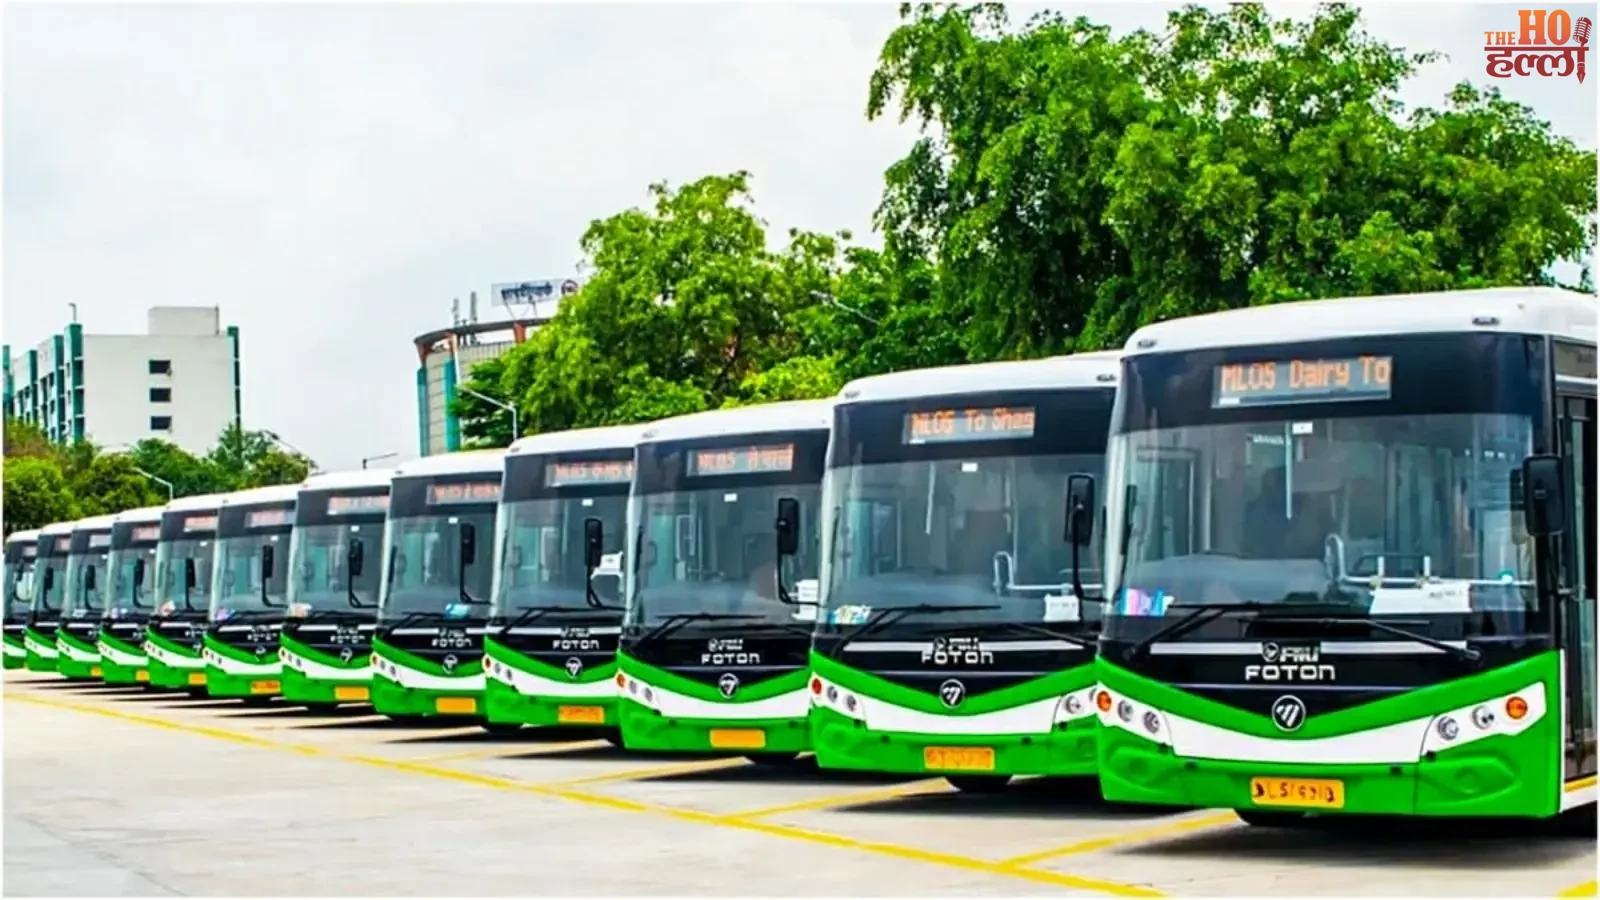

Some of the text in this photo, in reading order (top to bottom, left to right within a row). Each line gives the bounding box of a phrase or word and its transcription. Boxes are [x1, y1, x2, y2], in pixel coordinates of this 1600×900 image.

[1289, 359, 1350, 388] Dairy
[1359, 355, 1391, 384] To
[964, 408, 986, 431] To
[431, 638, 472, 648] FOTON
[552, 639, 600, 650] FOTON
[701, 652, 761, 665] FOTON
[921, 650, 995, 665] FOTON
[1245, 664, 1336, 681] FOTON
